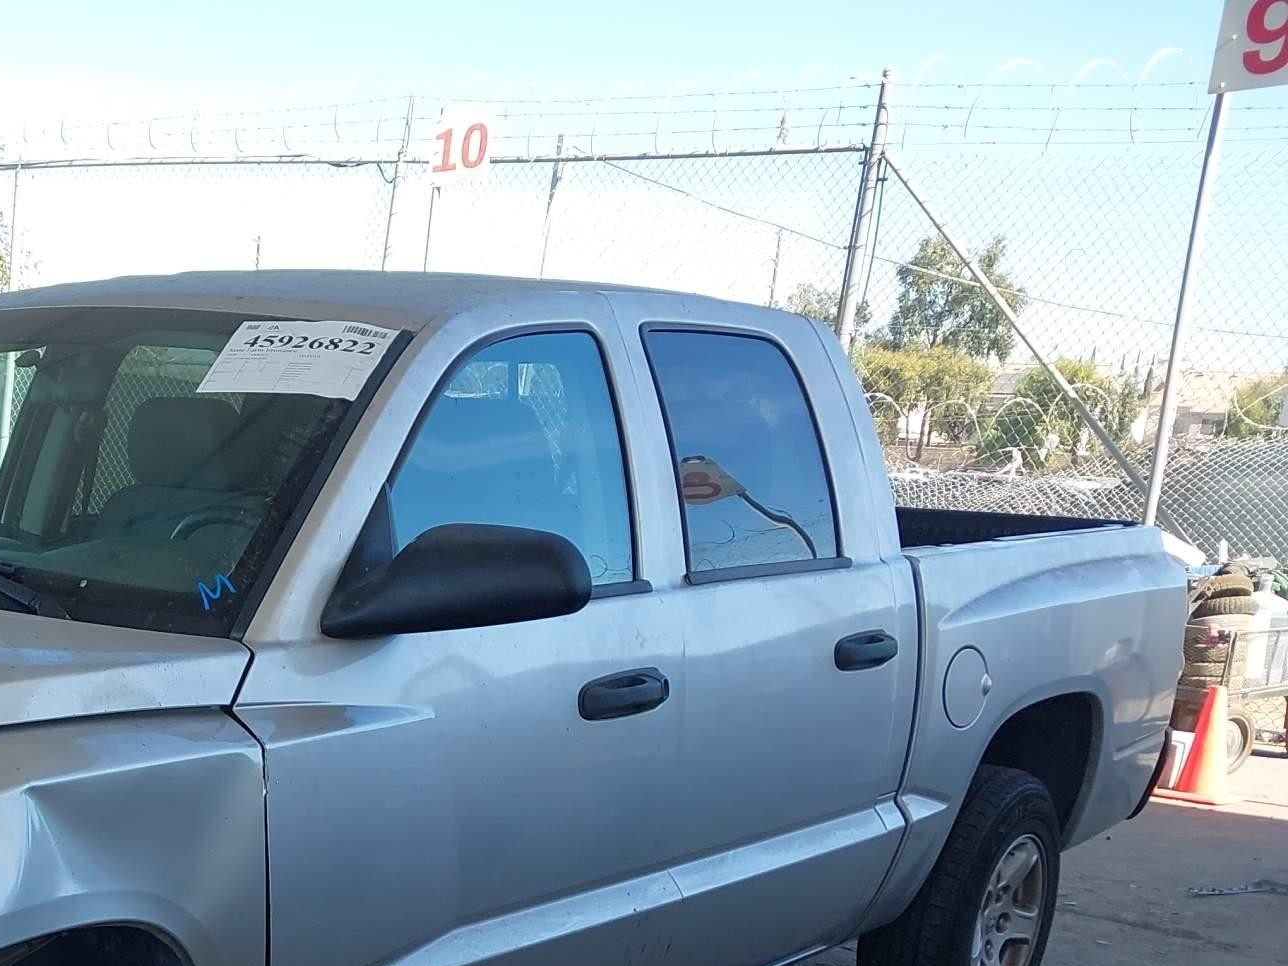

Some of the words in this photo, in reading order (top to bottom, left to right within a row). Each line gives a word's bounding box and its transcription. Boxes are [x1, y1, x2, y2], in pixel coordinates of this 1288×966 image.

[1242, 0, 1288, 75] 9
[432, 122, 488, 173] 10
[244, 334, 377, 355] 45926822
[197, 573, 238, 611] M
